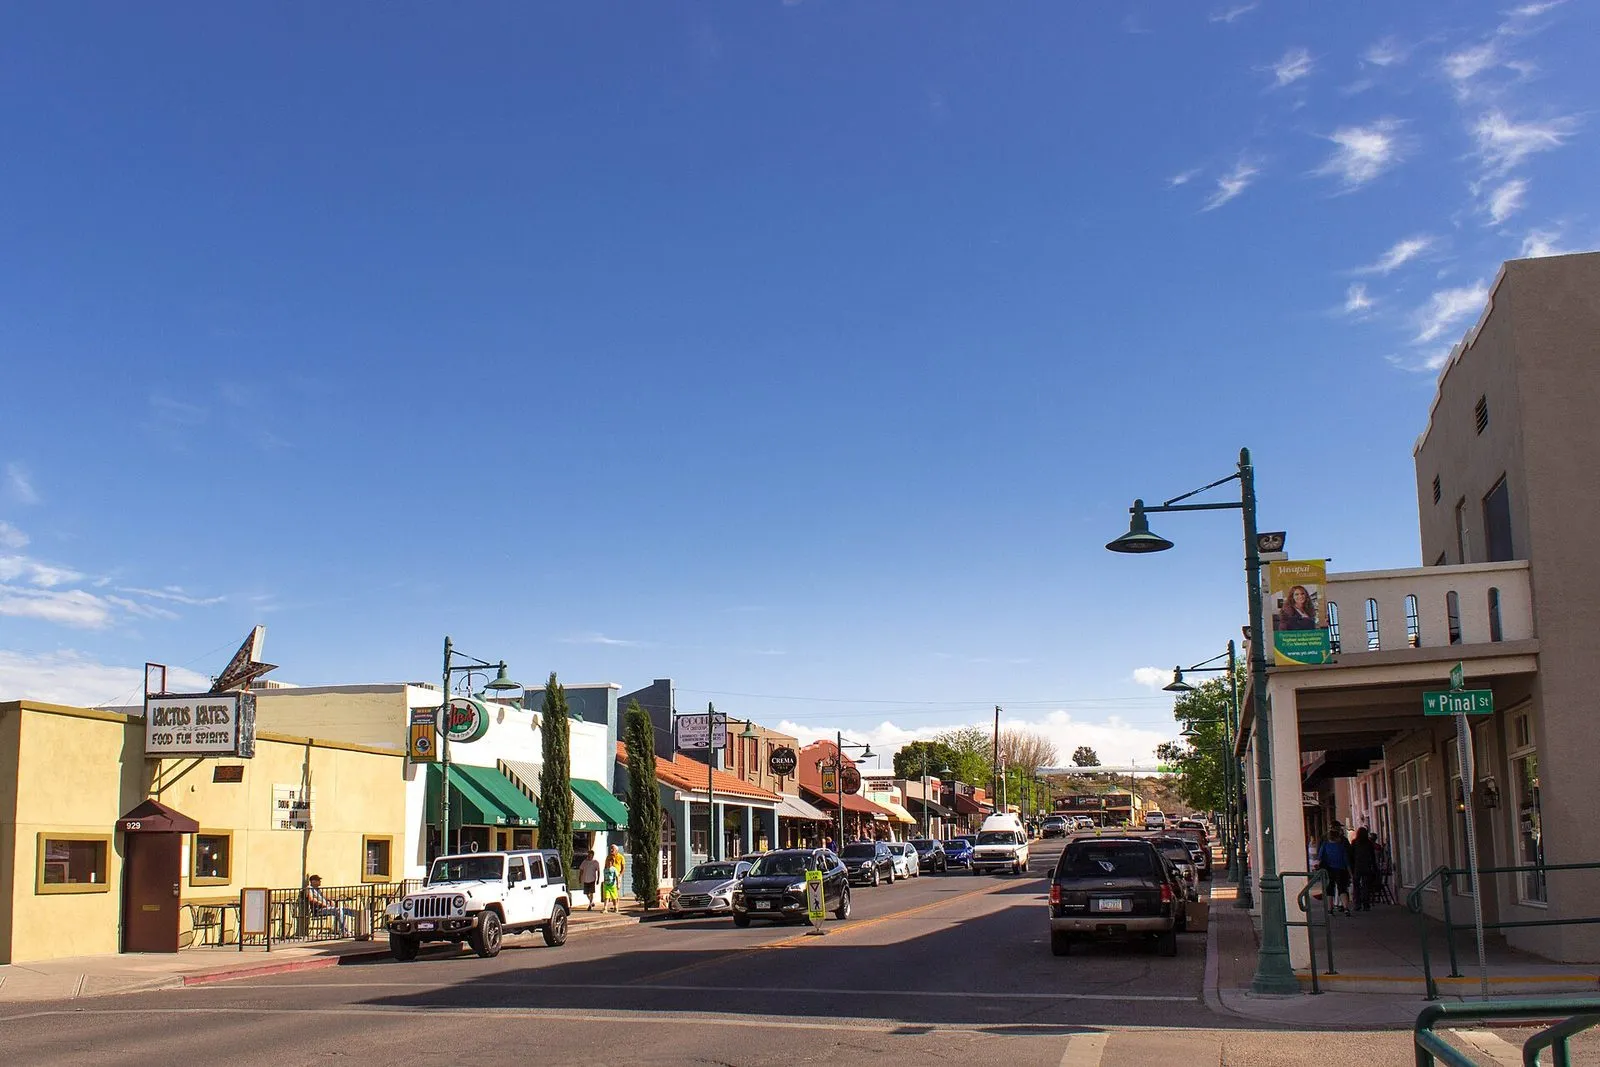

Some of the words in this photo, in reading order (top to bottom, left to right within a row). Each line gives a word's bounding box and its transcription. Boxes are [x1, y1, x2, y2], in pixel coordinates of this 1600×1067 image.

[1278, 565, 1310, 575] Yavapai
[1428, 699, 1435, 708] W
[1440, 694, 1476, 711] Pinal
[1479, 697, 1489, 707] St
[152, 706, 191, 726] KACTUS
[195, 704, 230, 725] KATES
[152, 732, 173, 745] FOOD
[176, 732, 192, 744] FUN
[195, 731, 229, 744] SPIRITS
[126, 822, 141, 830] 929
[280, 820, 292, 829] FREE
